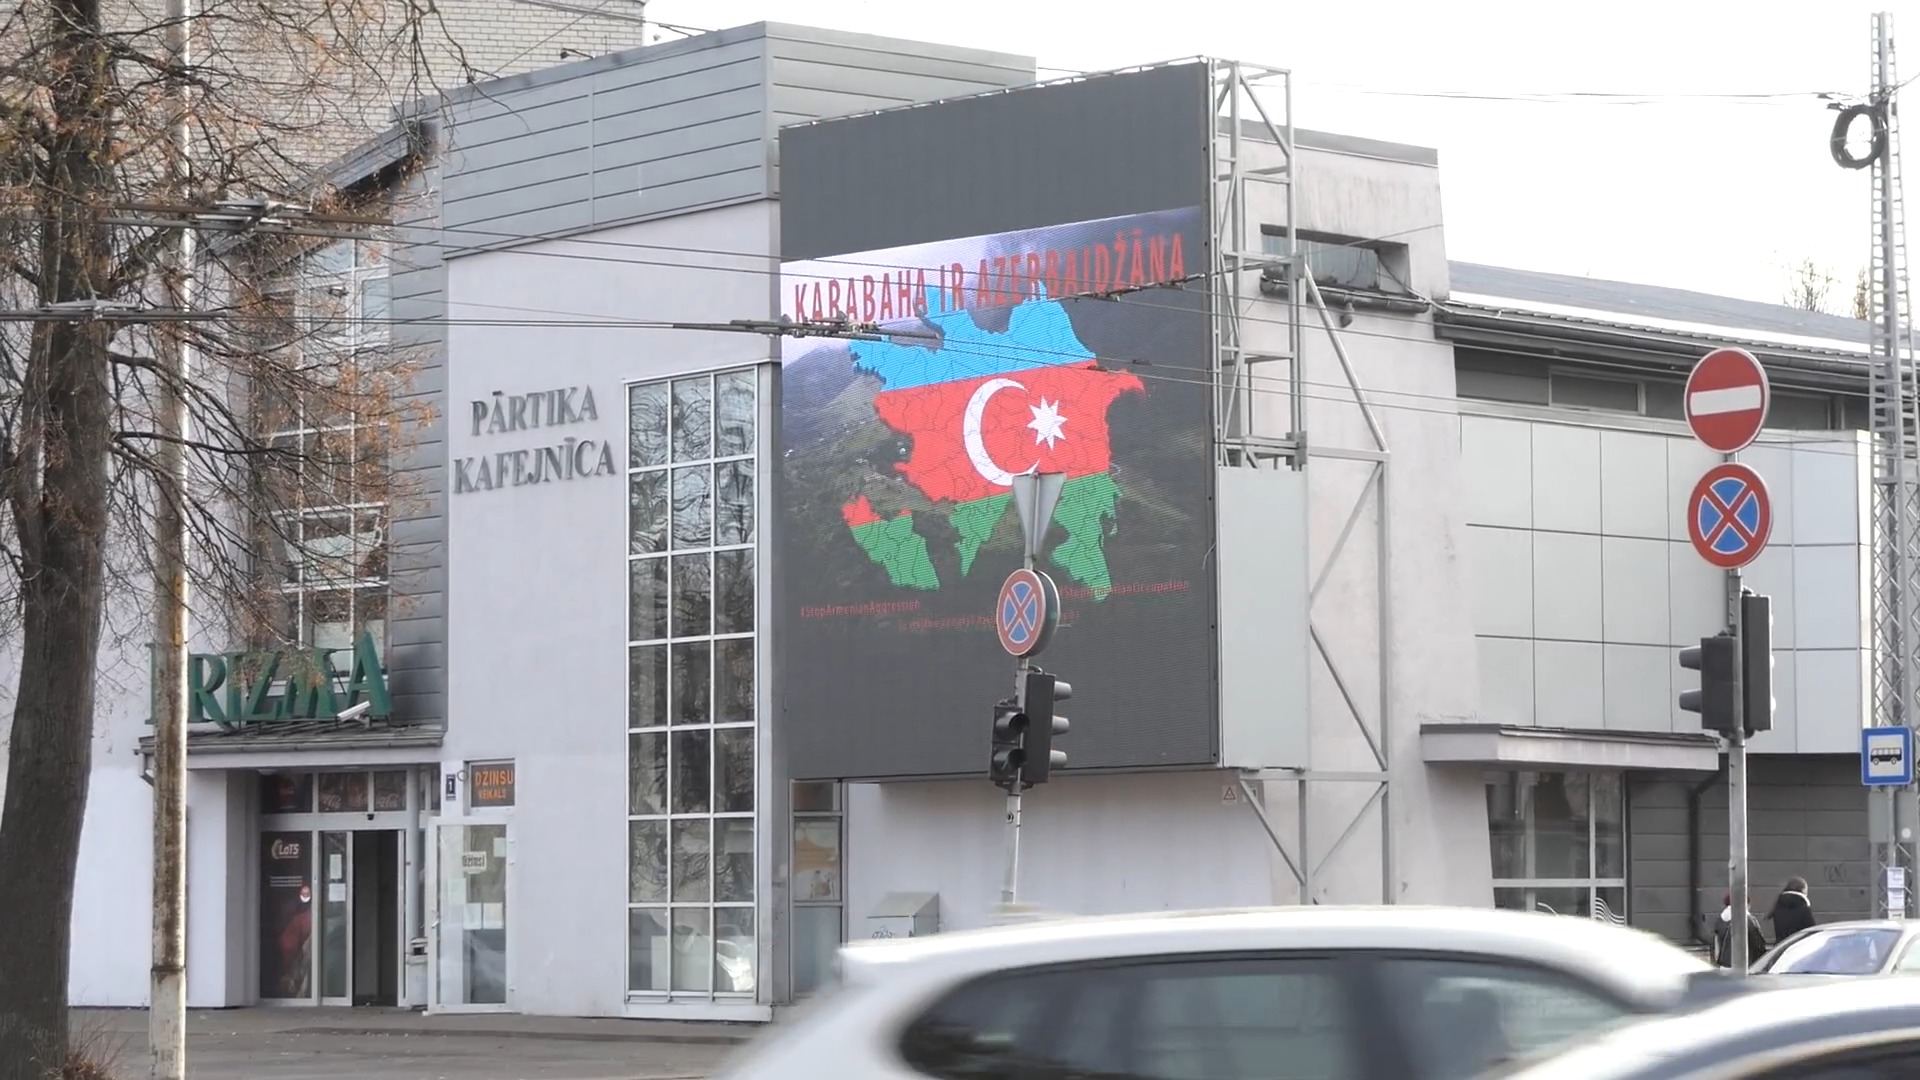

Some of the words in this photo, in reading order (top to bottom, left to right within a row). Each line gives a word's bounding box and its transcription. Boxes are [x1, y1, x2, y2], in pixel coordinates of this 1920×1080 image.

[795, 268, 928, 324] KARABAHA
[940, 262, 964, 313] IR
[976, 228, 1185, 309] AZERBAIDŽĀNA
[471, 385, 598, 436] PĀRTIKA
[453, 437, 616, 494] KAFEJNĪCA
[145, 631, 392, 732] RIZMA
